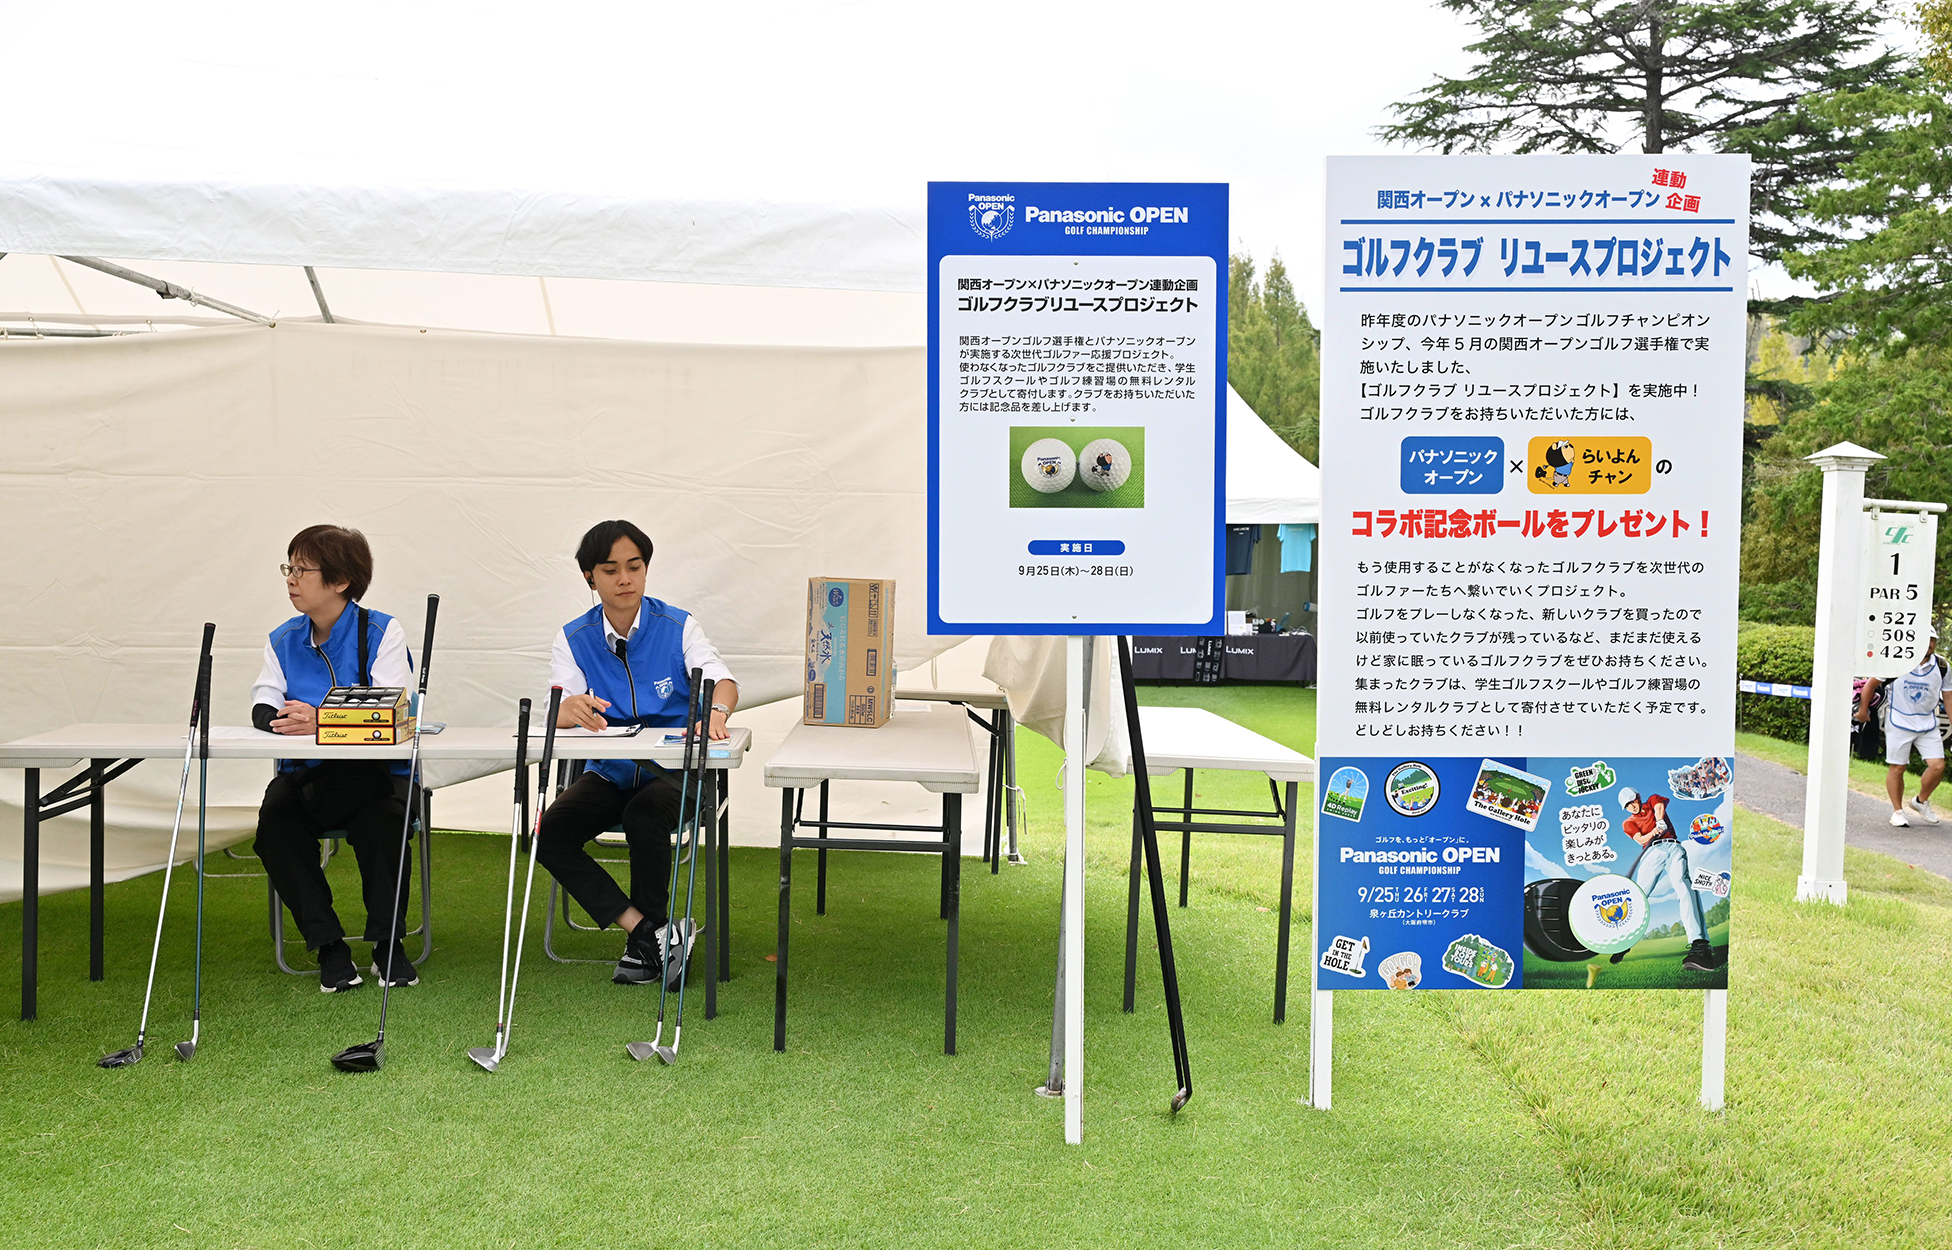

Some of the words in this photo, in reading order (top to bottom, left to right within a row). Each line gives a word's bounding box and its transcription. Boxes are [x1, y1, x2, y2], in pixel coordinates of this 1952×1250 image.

[1652, 168, 1687, 189] 連動
[969, 194, 1015, 203] Panasonic
[1378, 190, 1475, 209] 関西オープン
[1496, 189, 1660, 209] パナソニックオープン
[1665, 192, 1701, 213] 企画
[1026, 206, 1125, 223] Panasonic
[1130, 207, 1188, 223] OPEN
[1065, 226, 1084, 235] GOLF
[1087, 226, 1148, 235] CHAMPIONSHIP
[1342, 236, 1484, 277] ゴルフクラブ
[1500, 236, 1731, 277] リユースプロジェクト
[958, 278, 1198, 291] 関西オープン×パナソニックオープン連動企画
[958, 296, 1198, 313] ゴルフクラブリユースプロジェクト
[960, 336, 1195, 346] 関西オープンゴルフ選手権とパナソニックオープン
[960, 349, 1174, 359] が実施する次世代ゴルファー応援プロジェクト。
[959, 362, 1195, 373] 使わなくなったゴルフクラブをご提供いただき、学生
[1360, 360, 1470, 374] 施いたしました、
[960, 376, 1195, 386] ゴルフスクールやゴルフ練習場の無料レンタル
[960, 389, 1195, 399] クラブとして寄付します。クラブをお持ちいただいた
[959, 402, 1096, 412] 方には記念品を差し上げます。
[1361, 406, 1634, 421] ゴルフクラブをお持ちいただいた方には、
[1409, 449, 1497, 464] パナソニック
[1582, 449, 1640, 464] らいよん
[1656, 459, 1672, 474] の
[1424, 469, 1483, 485] オープン
[1588, 470, 1633, 485] チャン
[1352, 509, 1708, 538] コラボ記念ボールをプレゼント！
[1060, 543, 1092, 552] 実施日
[1358, 561, 1704, 574] もう使用することがなくなったゴルフクラブを次世代の
[1891, 553, 1899, 575] 1
[1357, 584, 1625, 597] ゴルファーたちへ繋いでいくプロジェクト。
[1870, 588, 1900, 599] PAR
[1906, 584, 1918, 600] 5
[1357, 607, 1702, 621] ゴルフをプレーしなくなった、新しいクラブを買ったので
[1883, 612, 1916, 625] 527
[1356, 631, 1701, 644] 以前使っていたクラブが残っているなど、まだまだ使える
[1882, 629, 1915, 642] 508
[820, 630, 832, 664] 天然水
[1134, 646, 1163, 654] LUMIX
[1180, 646, 1196, 654] LUM
[1226, 646, 1254, 655] LUMIX
[1880, 646, 1914, 659] 425
[1357, 654, 1707, 667] けど家に眠っているゴルフクラブをぜひお持ちください。
[1355, 677, 1700, 691] 集まったクラブは、学生ゴルフスクールやゴルフ練習場の
[1355, 701, 1706, 714] 無料レンタルクラブとして寄付させていただく予定です。
[1574, 769, 1593, 780] GREEN
[1401, 783, 1428, 795] Exciting!
[1578, 783, 1599, 794] JOCKEY
[1336, 803, 1358, 816] Replay
[1474, 801, 1487, 810] The
[1488, 805, 1514, 819] Gallery
[1514, 815, 1531, 825] Hole
[1562, 806, 1600, 821] あなたに
[1564, 821, 1606, 834] ピッタリの
[1565, 835, 1604, 850] 楽しみが
[1340, 847, 1438, 863] Panasonic
[1442, 847, 1500, 863] OPEN
[1567, 850, 1615, 864] きっとある。
[1379, 866, 1398, 874] GOLF
[1400, 866, 1461, 874] CHAMPIONSHIP
[1698, 874, 1712, 882] NICE
[1358, 887, 1394, 903] 9/25
[1404, 887, 1423, 903] 26
[1432, 887, 1450, 903] 27
[1459, 887, 1479, 903] 28
[1592, 889, 1631, 902] Panasonic
[1601, 897, 1623, 907] OPEN
[1336, 938, 1355, 952] GET
[1454, 944, 1477, 958] INSIDE
[1340, 951, 1352, 960] THE
[1454, 950, 1474, 962] ROPE
[1323, 956, 1350, 971] HOLE
[1450, 956, 1473, 969] TOURS
